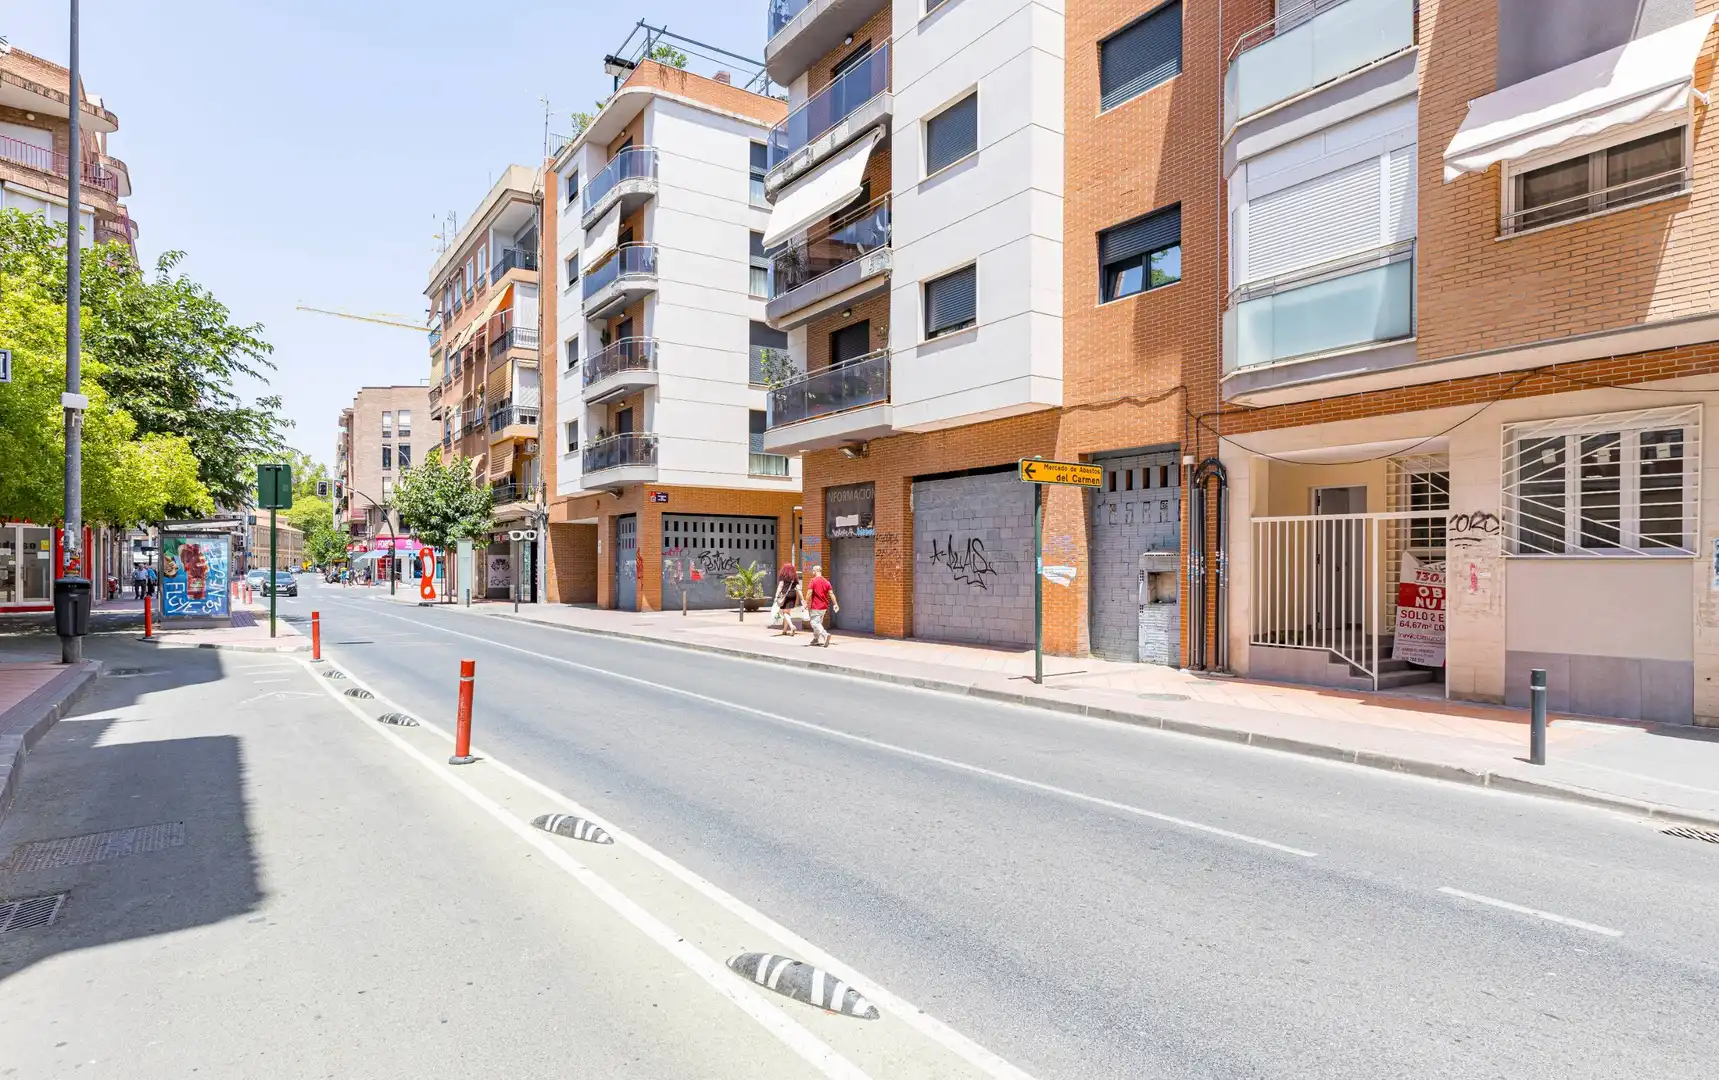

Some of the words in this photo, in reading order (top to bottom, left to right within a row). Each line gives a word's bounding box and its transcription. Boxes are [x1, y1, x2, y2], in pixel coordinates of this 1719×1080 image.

[1043, 464, 1067, 472] Mercado
[1079, 467, 1100, 475] Abastos
[1056, 474, 1068, 482] del
[1072, 475, 1100, 484] Carmen
[1401, 609, 1428, 621] SOLO
[1430, 613, 1436, 622] 2
